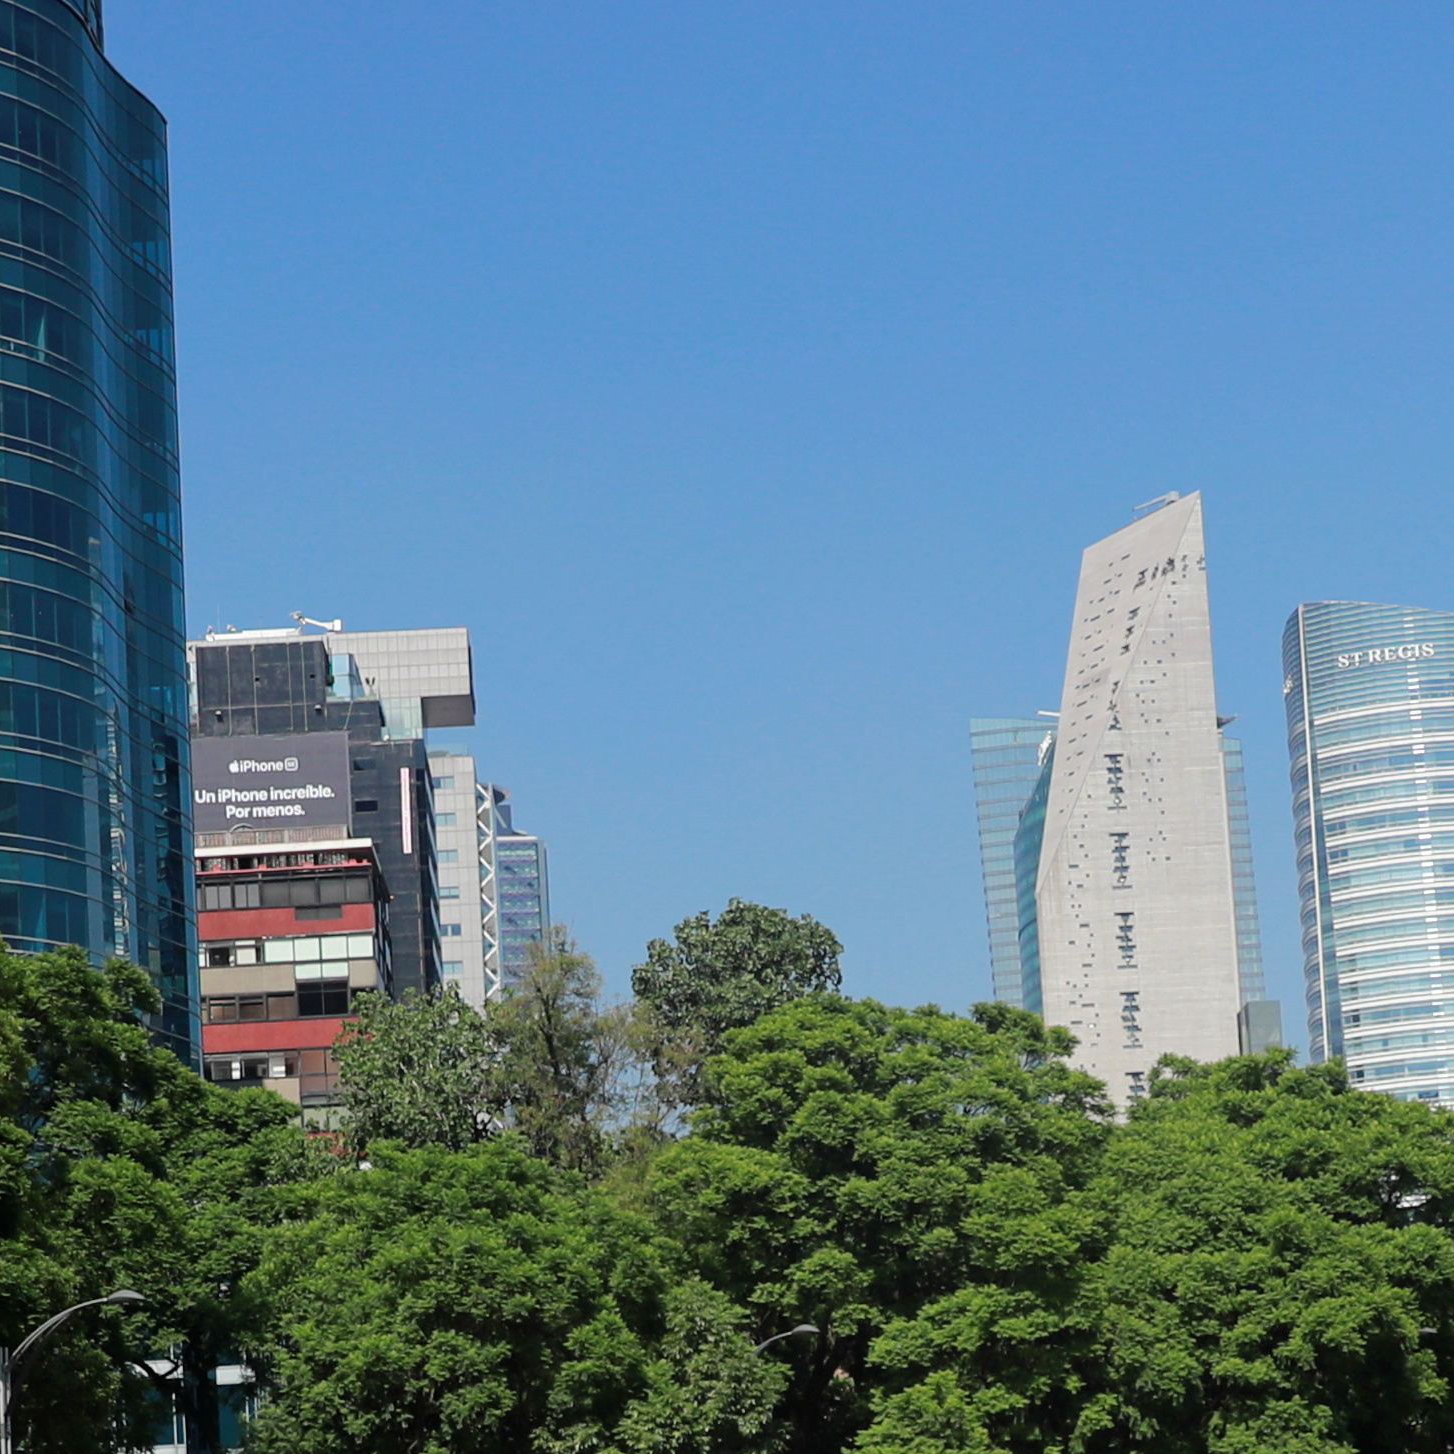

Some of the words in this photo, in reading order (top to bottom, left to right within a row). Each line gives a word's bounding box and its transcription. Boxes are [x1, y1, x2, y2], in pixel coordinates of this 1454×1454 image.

[1368, 642, 1435, 664] REGIS
[240, 759, 284, 773] iPhone
[195, 789, 216, 804] Un
[218, 788, 267, 803] iPhone
[270, 784, 336, 801] increíble.
[226, 805, 251, 819] Por
[253, 804, 305, 818] menos.
